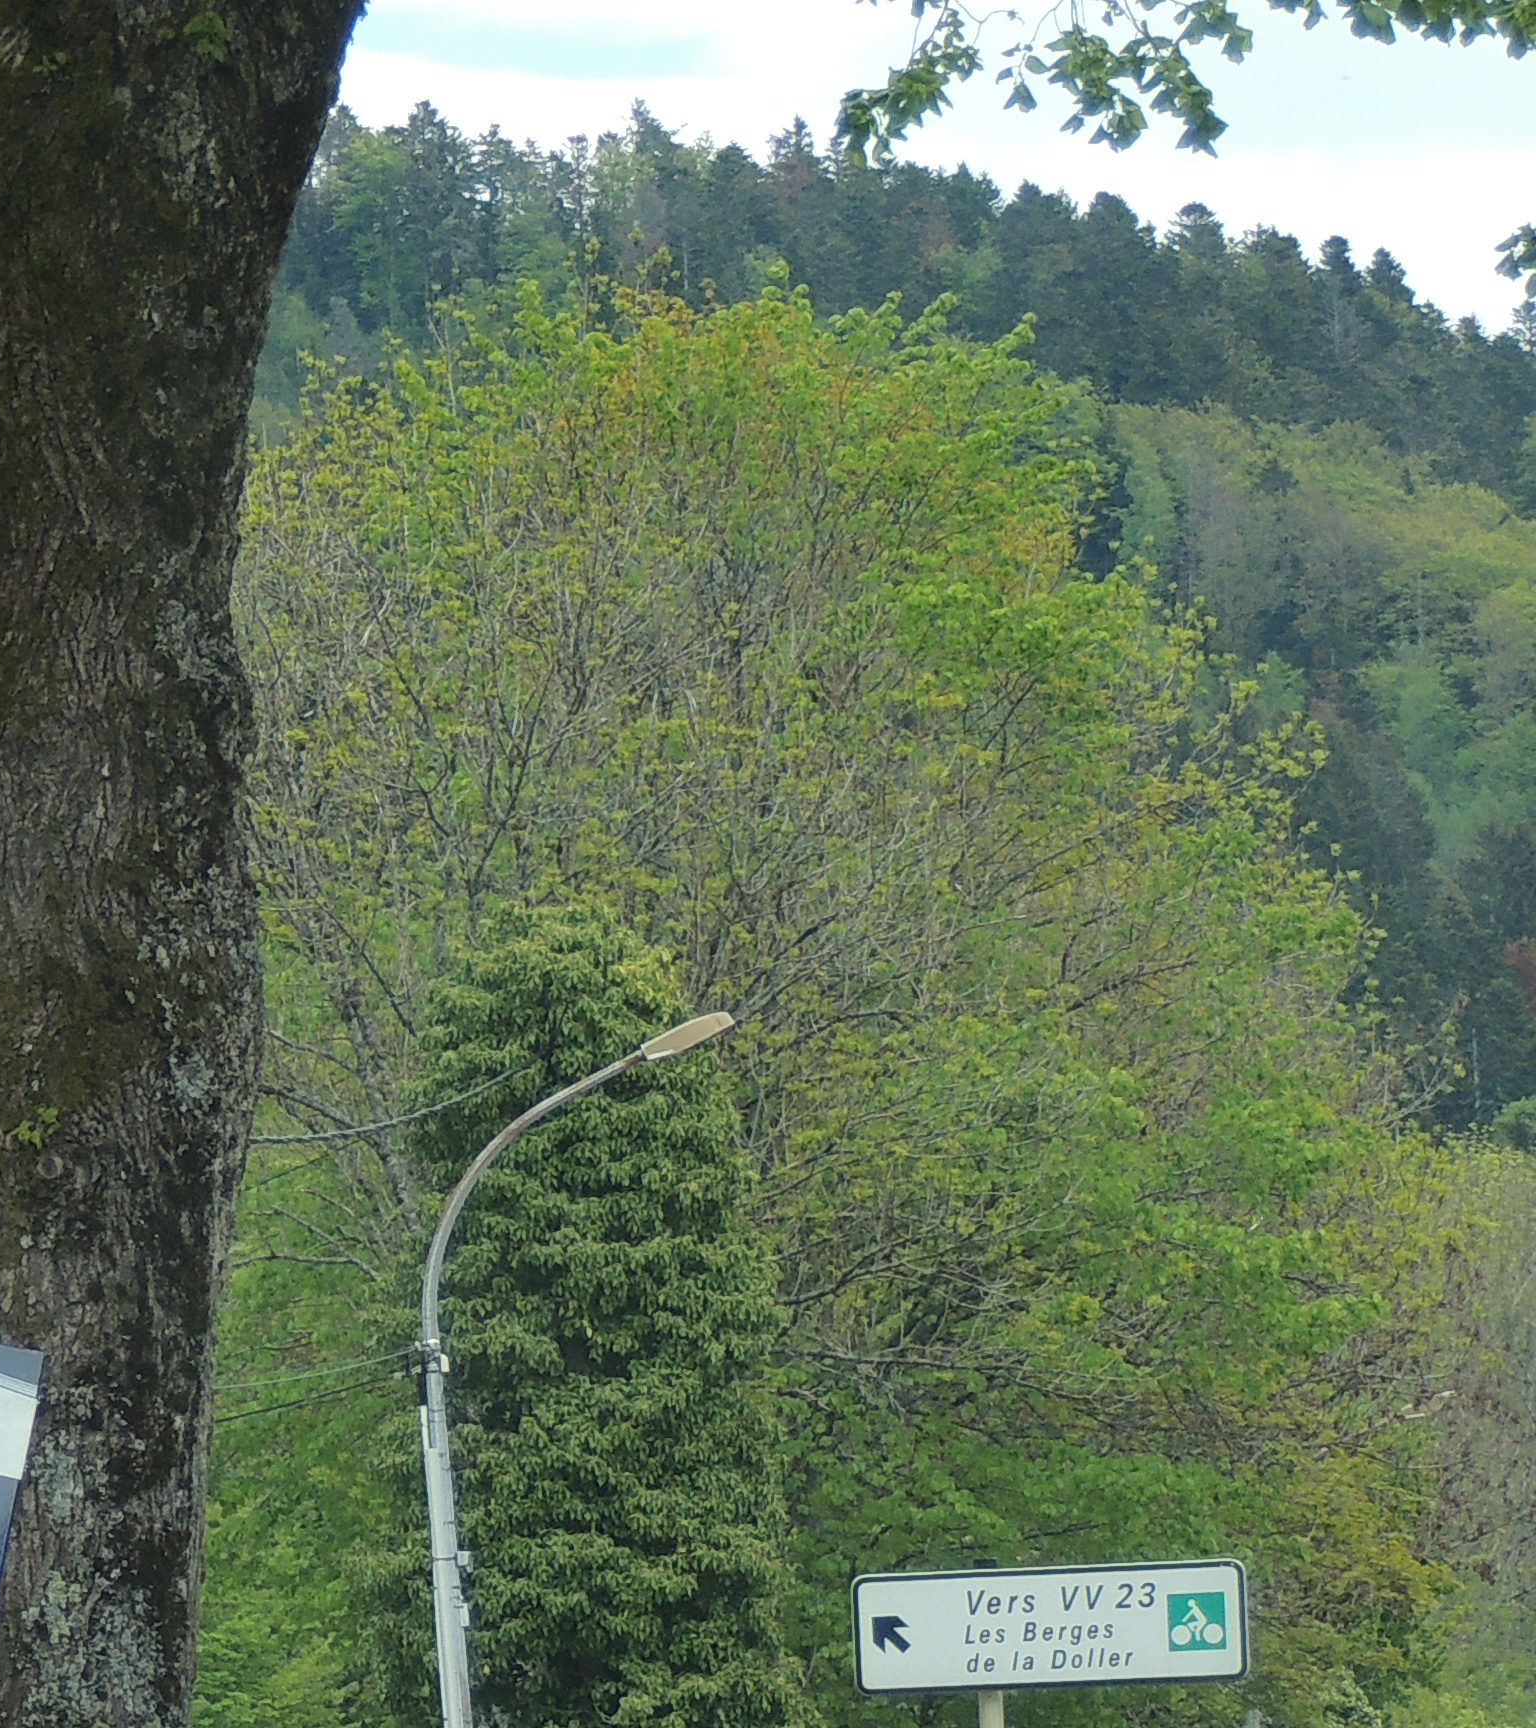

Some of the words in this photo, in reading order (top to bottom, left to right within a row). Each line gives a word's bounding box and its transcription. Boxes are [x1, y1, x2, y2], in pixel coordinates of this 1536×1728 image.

[965, 1589, 1036, 1616] Vers
[1060, 1584, 1105, 1612] VV
[1115, 1582, 1158, 1609] 23
[964, 1623, 1006, 1645] Les
[1022, 1620, 1116, 1646] Berges
[966, 1652, 996, 1673] de
[1012, 1650, 1035, 1671] la
[1051, 1647, 1135, 1670] Doller
